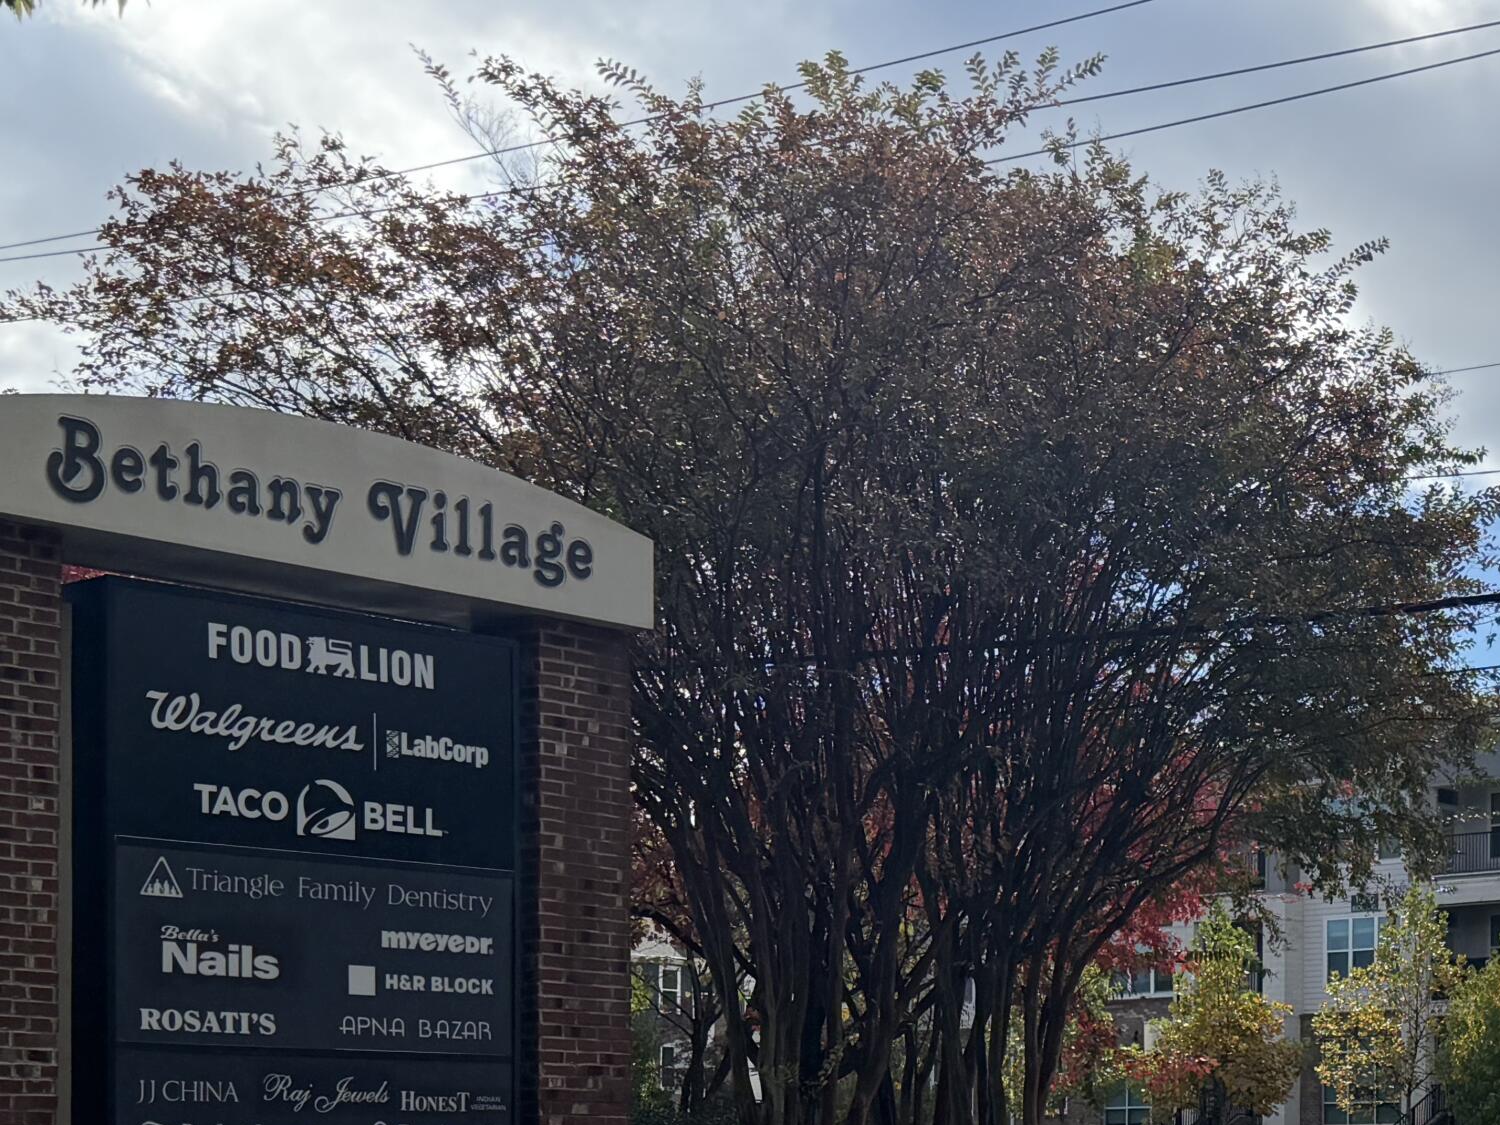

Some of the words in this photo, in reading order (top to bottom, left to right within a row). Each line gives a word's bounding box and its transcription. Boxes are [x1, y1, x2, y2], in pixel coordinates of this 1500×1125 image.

[47, 412, 339, 543] Bethany
[367, 477, 593, 587] Village
[207, 622, 301, 670] FOOD
[360, 645, 435, 690] LION
[145, 689, 364, 751] Walgreens
[401, 732, 489, 768] LabCorp
[193, 783, 289, 821] TACO
[364, 801, 443, 837] BELL
[186, 867, 284, 898] Triangle
[299, 877, 376, 910] Family
[388, 885, 493, 918] Dentistry
[160, 925, 219, 942] Bella's
[161, 941, 280, 980] Nails
[385, 974, 426, 992] H&R
[431, 976, 494, 995] BLOCK
[139, 1007, 276, 1036] ROSATI'S
[338, 1015, 405, 1038] APNA
[418, 1020, 492, 1041] BAZAR
[162, 1080, 239, 1103] CHINA
[263, 1073, 312, 1113] Raj
[314, 1076, 390, 1113] Jewels
